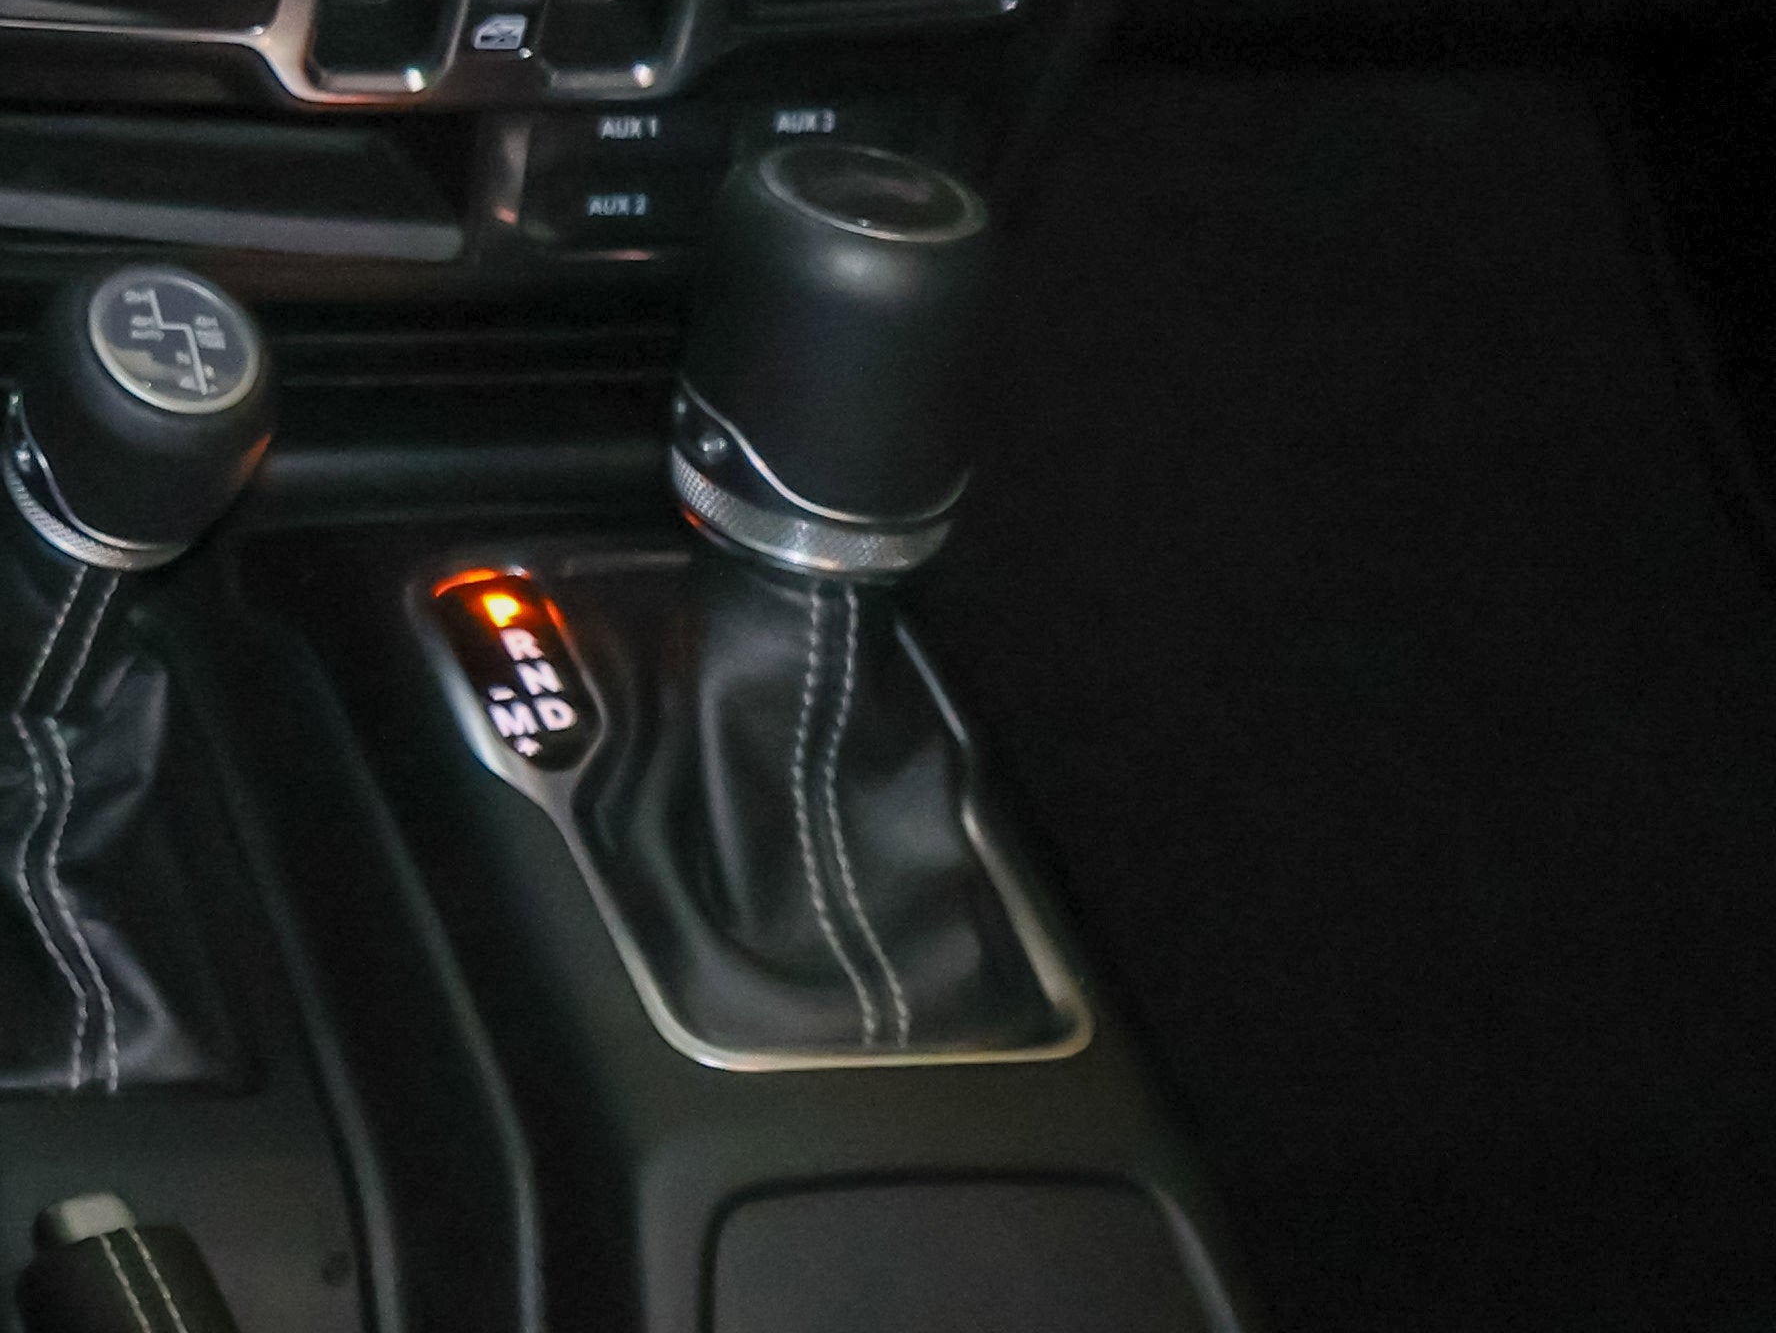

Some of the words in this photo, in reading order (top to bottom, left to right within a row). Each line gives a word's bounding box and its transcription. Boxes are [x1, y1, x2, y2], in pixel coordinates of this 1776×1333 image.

[600, 116, 642, 139] AUX
[500, 628, 544, 661] R
[515, 660, 563, 695] N
[488, 702, 540, 737] M
